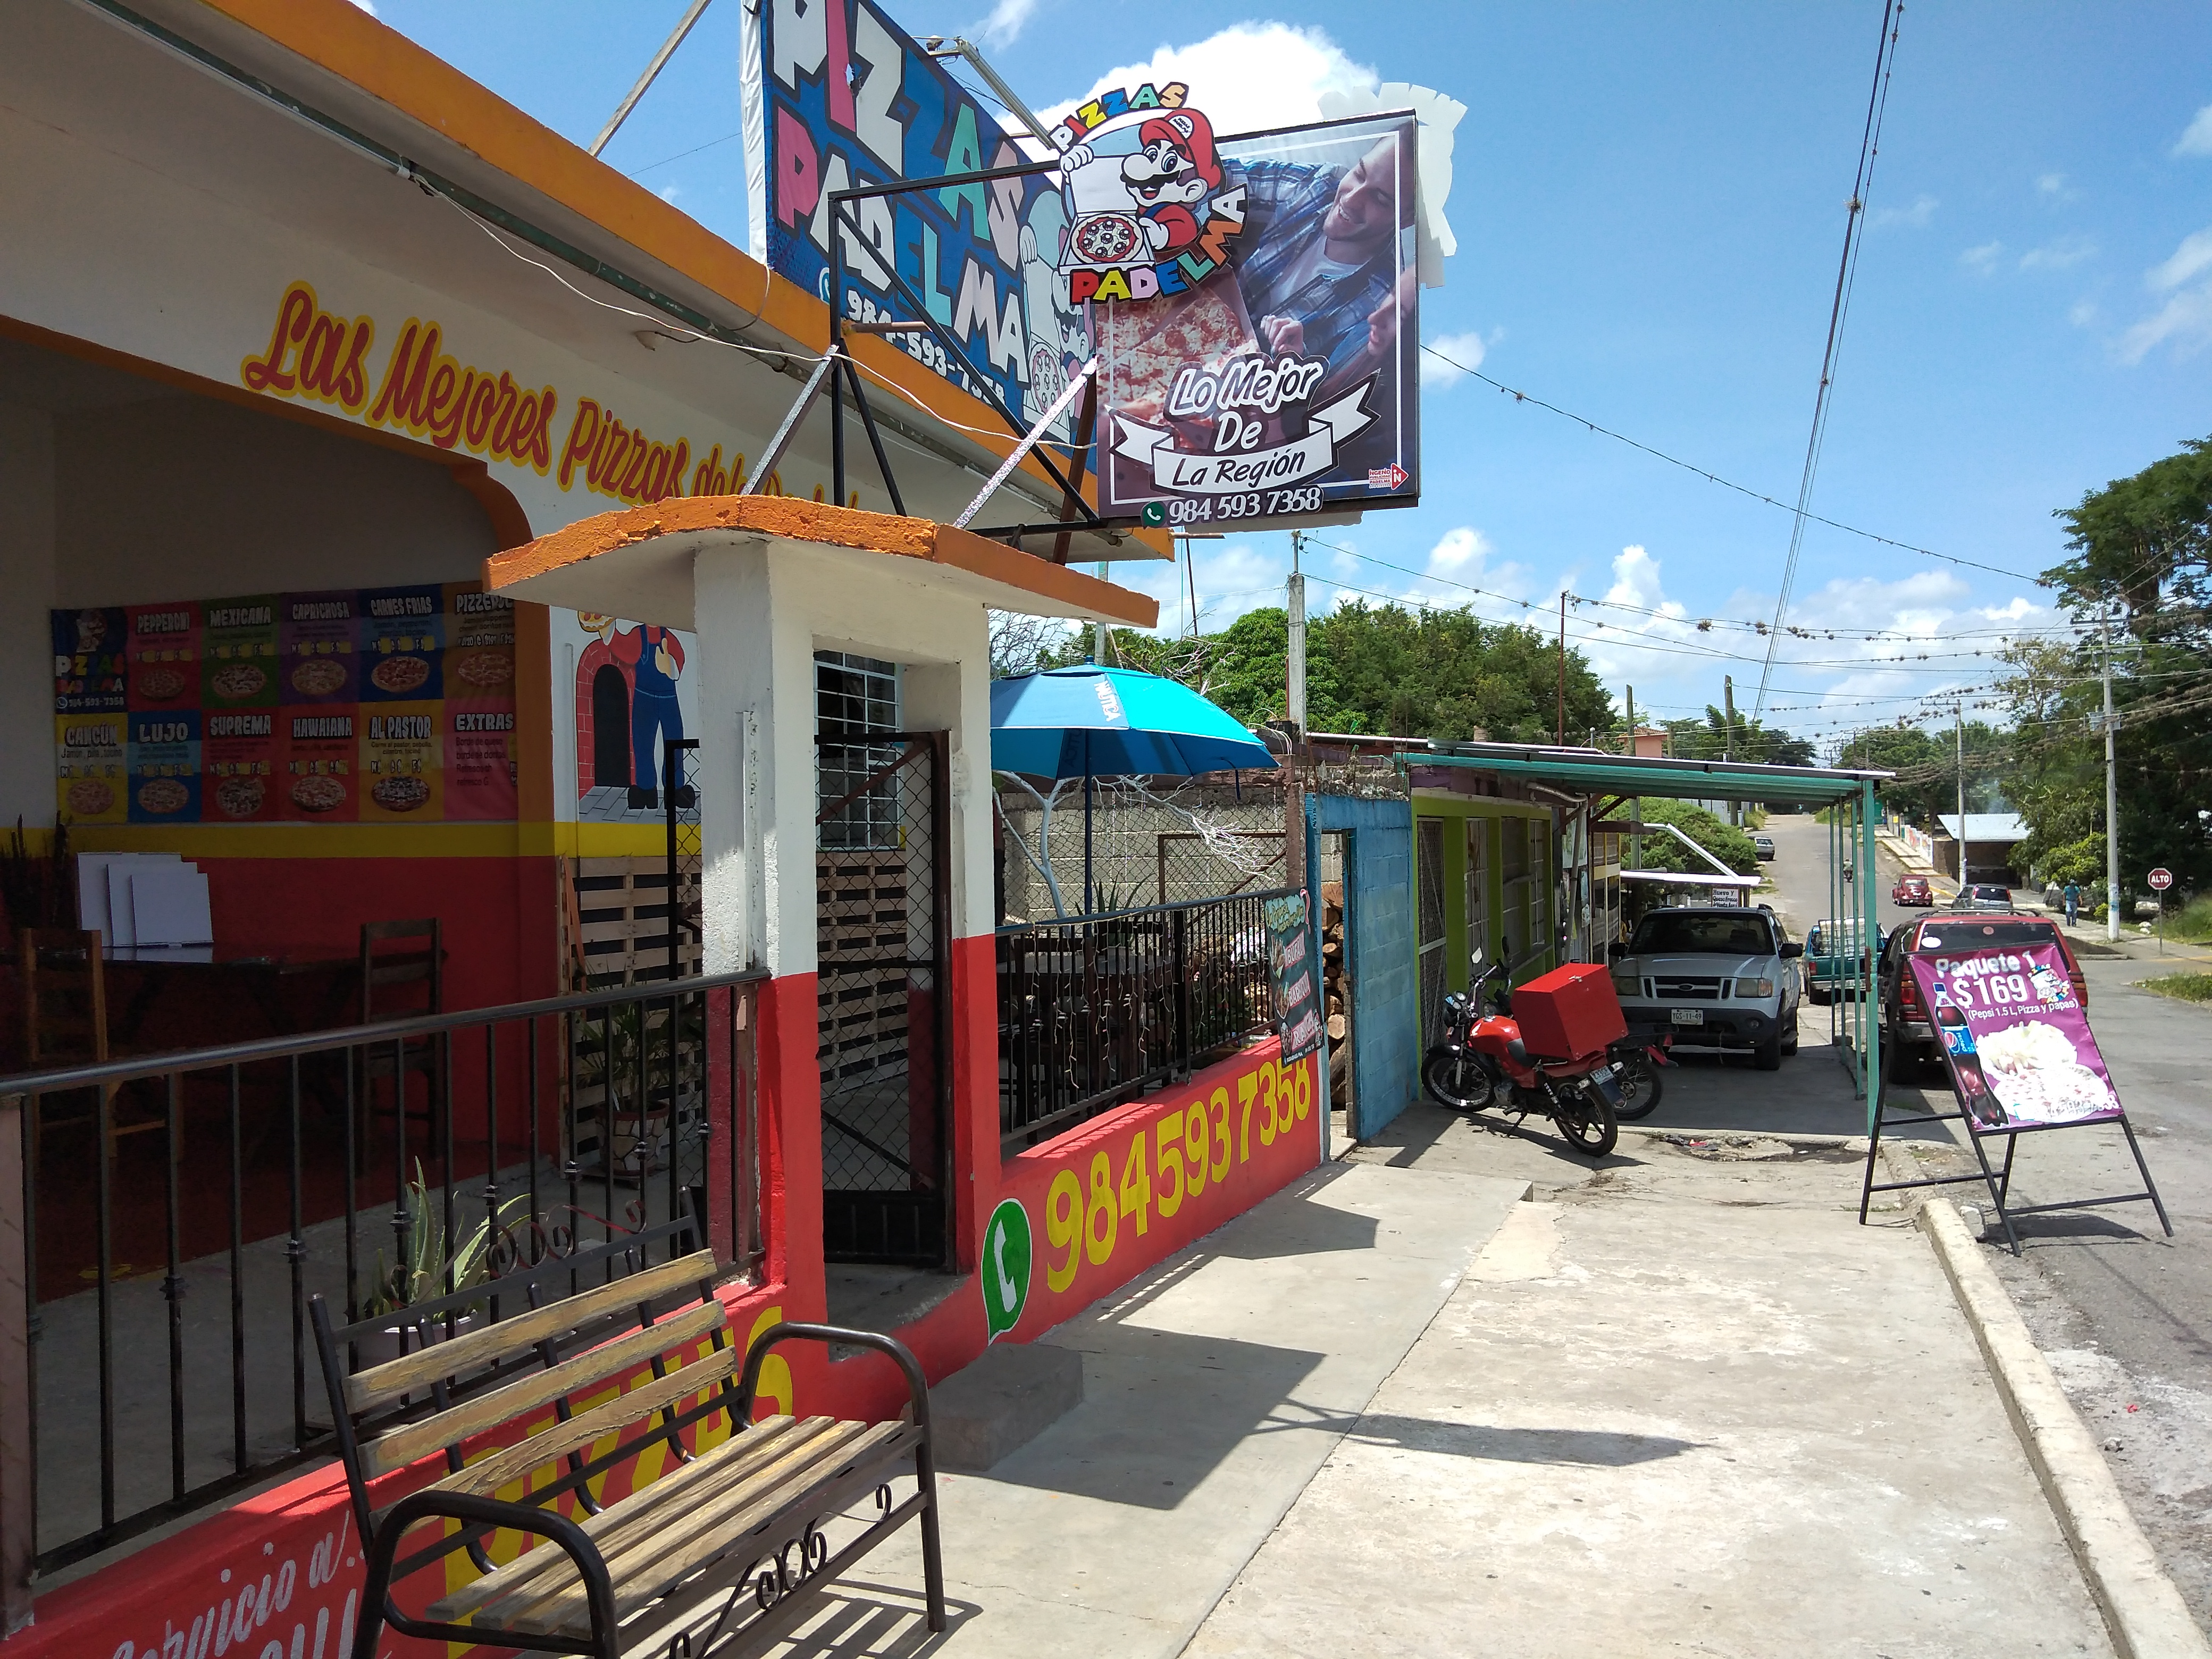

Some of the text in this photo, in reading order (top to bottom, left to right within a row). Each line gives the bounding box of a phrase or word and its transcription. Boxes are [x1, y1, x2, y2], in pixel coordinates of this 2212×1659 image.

[1048, 81, 1189, 153] PIZZAS
[1070, 183, 1249, 305] PADELMA
[240, 280, 375, 417] Las
[365, 316, 558, 477] Mejores
[557, 396, 691, 507] Pizzas
[1169, 356, 1324, 415] Lo Mejor
[1214, 412, 1261, 453] De
[1171, 448, 1306, 488] La Región
[1169, 487, 1321, 524] 984 593 7358
[210, 606, 272, 627] MEXICANA
[292, 601, 350, 621] CAPRICHOSA
[371, 596, 433, 616] CARNES FRIAS
[137, 611, 190, 634] PEPPERONI
[1094, 680, 1121, 722] NAUTICA
[139, 722, 189, 742] LUJO
[210, 714, 272, 736] SUPREMA
[292, 716, 352, 739] HAWAIANA
[370, 715, 432, 739] AL PASTOR
[456, 713, 514, 731] EXTRAS
[1935, 953, 2021, 979] Paquete
[1952, 974, 2029, 1009] $169
[1968, 1009, 1995, 1021] (Pepsi
[1995, 1007, 2008, 1017] 1.5
[2018, 1005, 2040, 1014] Pizza
[2040, 1004, 2047, 1014] y
[2049, 998, 2079, 1012] papas)
